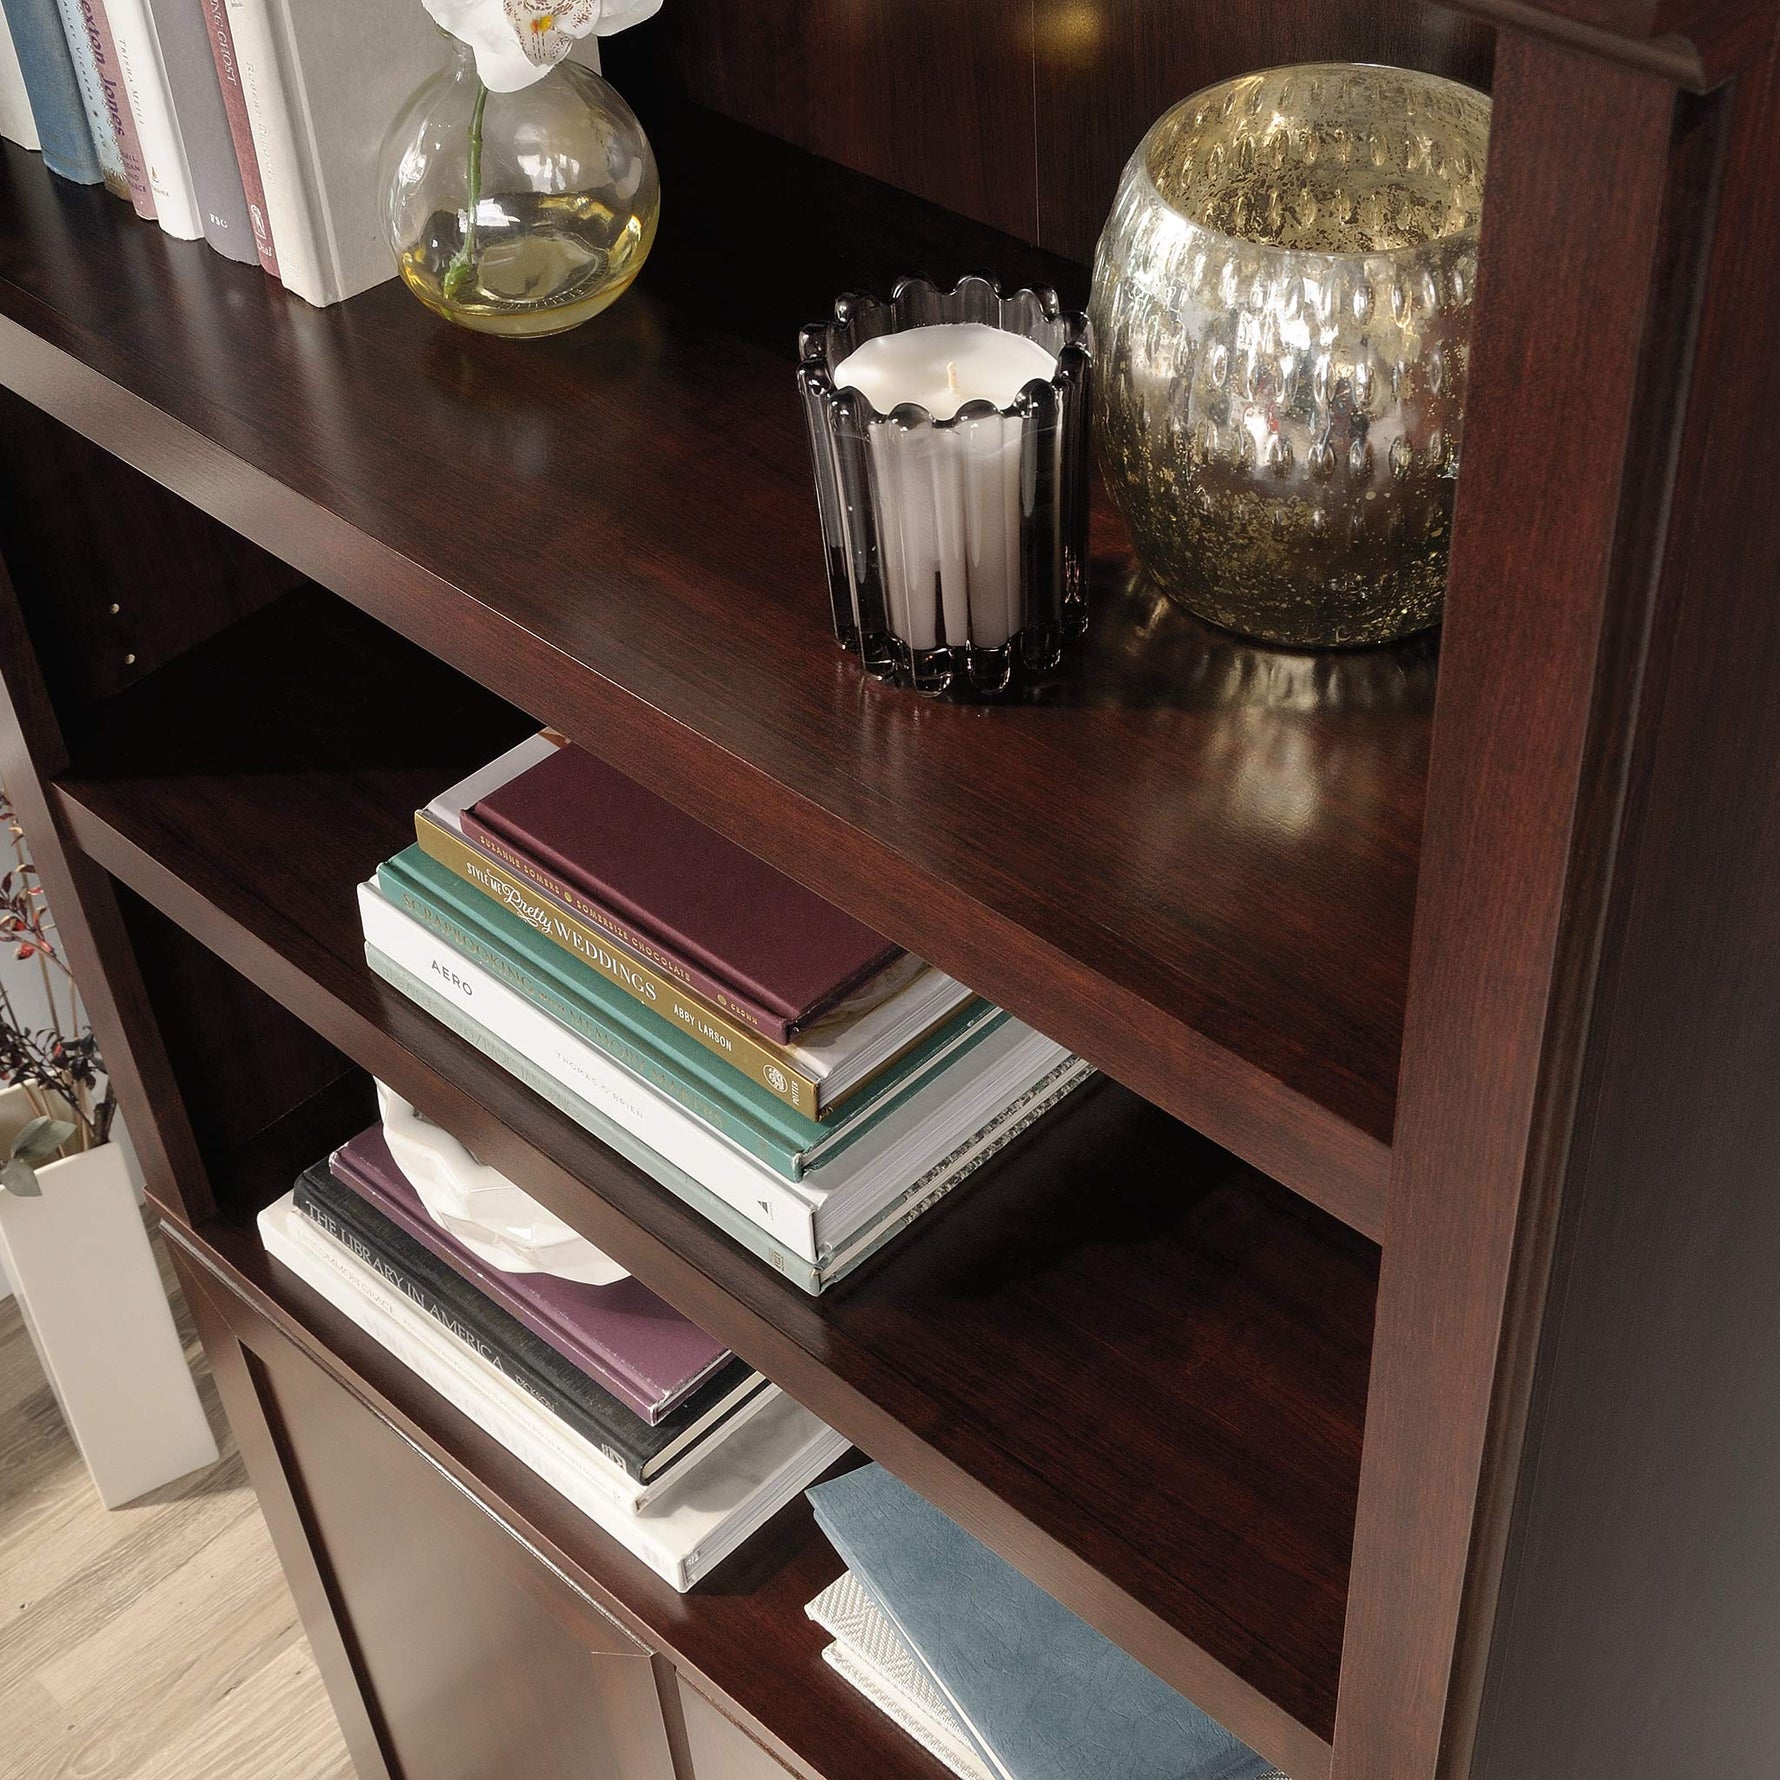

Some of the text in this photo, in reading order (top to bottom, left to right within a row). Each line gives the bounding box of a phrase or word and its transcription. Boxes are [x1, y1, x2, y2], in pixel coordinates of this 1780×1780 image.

[217, 28, 237, 86] GHOST
[100, 73, 126, 137] Jones
[403, 891, 535, 996] SCRAPBOOKING
[466, 862, 732, 1052] STYLE ME Pretty WEDDINGS ABBY LARSON
[480, 835, 758, 1025] SUZANNE SOMERS SOMERSIZE CHOCOLATE CROWN
[431, 959, 473, 996] AERO
[791, 1080, 800, 1106] POTTER
[305, 1200, 338, 1237] THE
[340, 1227, 404, 1288] LIBRARY
[406, 1282, 425, 1308] IN
[429, 1304, 505, 1372] AMERICA
